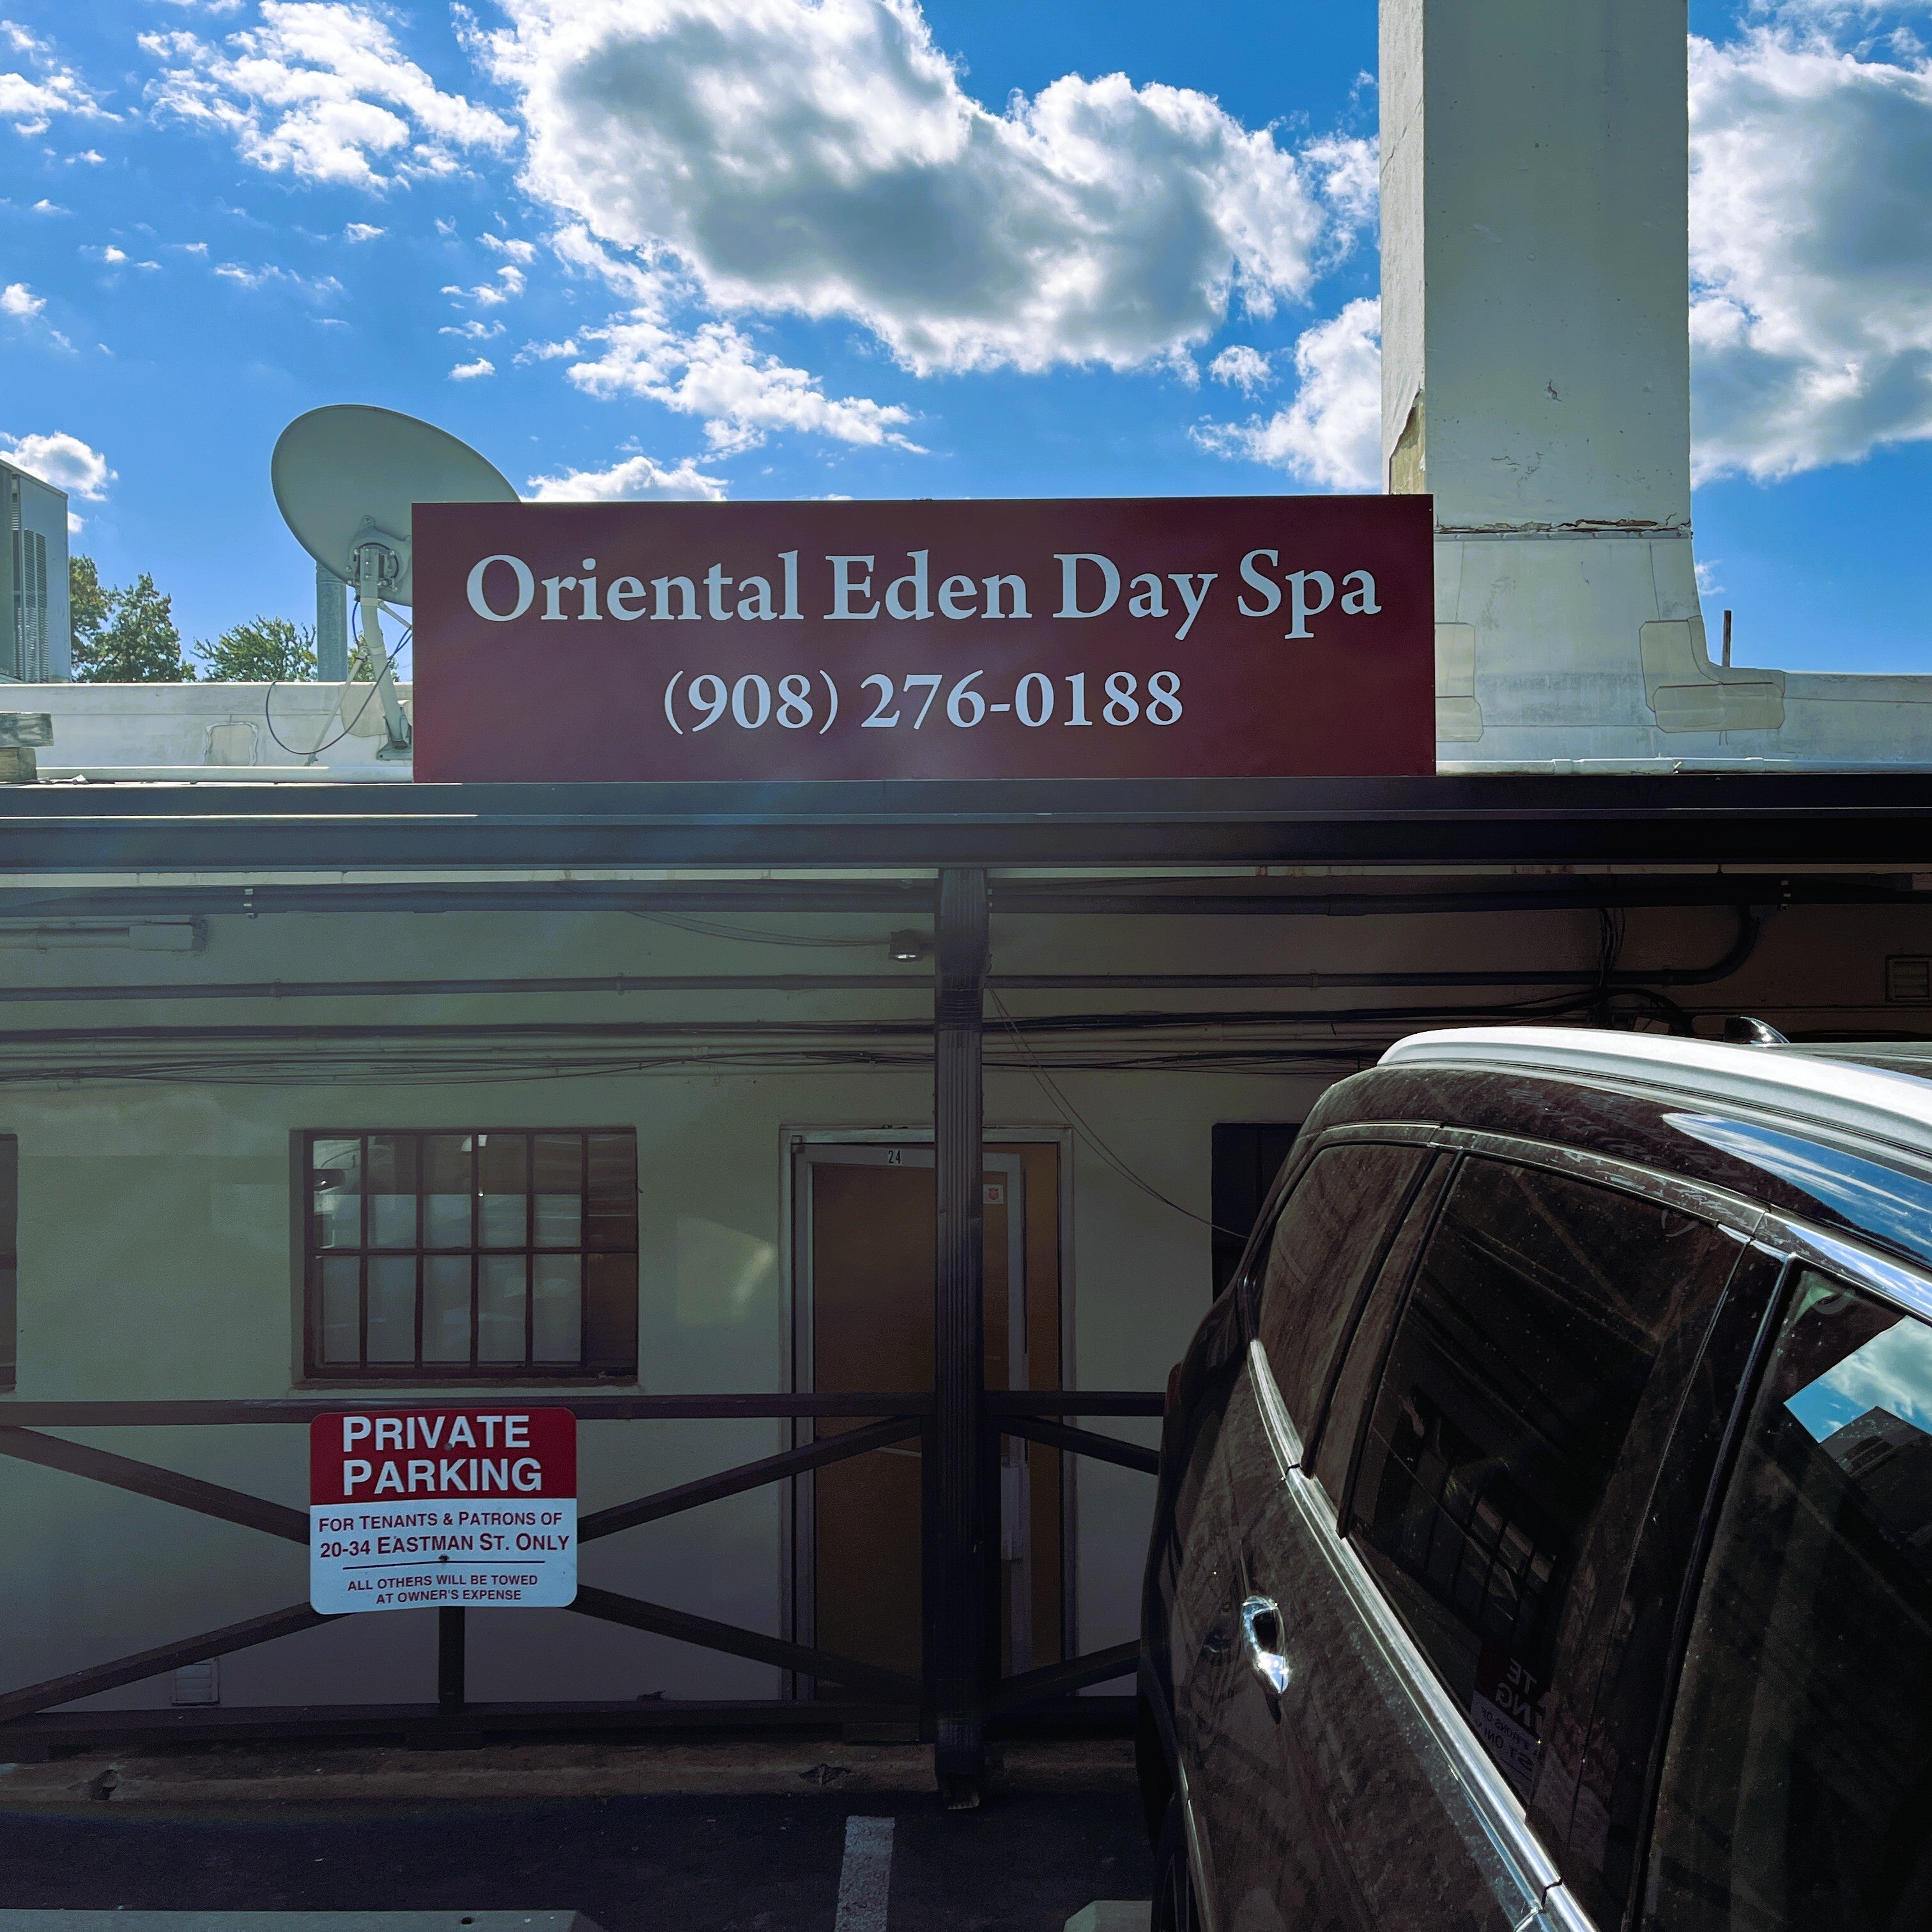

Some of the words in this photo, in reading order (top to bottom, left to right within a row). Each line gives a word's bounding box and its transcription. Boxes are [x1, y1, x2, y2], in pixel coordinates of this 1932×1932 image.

[467, 550, 804, 621] Oriental
[824, 549, 1032, 620] Eden
[1053, 554, 1218, 640] Day
[1238, 549, 1381, 639] Spa
[664, 670, 838, 735] (908)
[861, 670, 1182, 730] 276-0188
[888, 1150, 901, 1164] 24
[344, 1416, 529, 1452] PRIVATE
[344, 1458, 540, 1495] PARKING
[319, 1518, 353, 1532] FOR
[359, 1513, 437, 1529] TENANTS
[443, 1513, 453, 1525] &
[459, 1512, 535, 1525] PATRONS
[541, 1512, 562, 1525] OF
[321, 1540, 371, 1558] 20-34
[378, 1536, 473, 1554] EASTMAN
[480, 1533, 509, 1551] ST.
[516, 1533, 569, 1551] ONLY
[348, 1580, 373, 1591] ALL
[378, 1575, 432, 1589] OTHERS
[436, 1575, 466, 1584] WILL
[471, 1575, 487, 1584] BE
[491, 1575, 537, 1584] TOWED
[376, 1593, 394, 1604] AT
[398, 1590, 459, 1602] OWNER'S
[463, 1590, 521, 1600] EXPENSE
